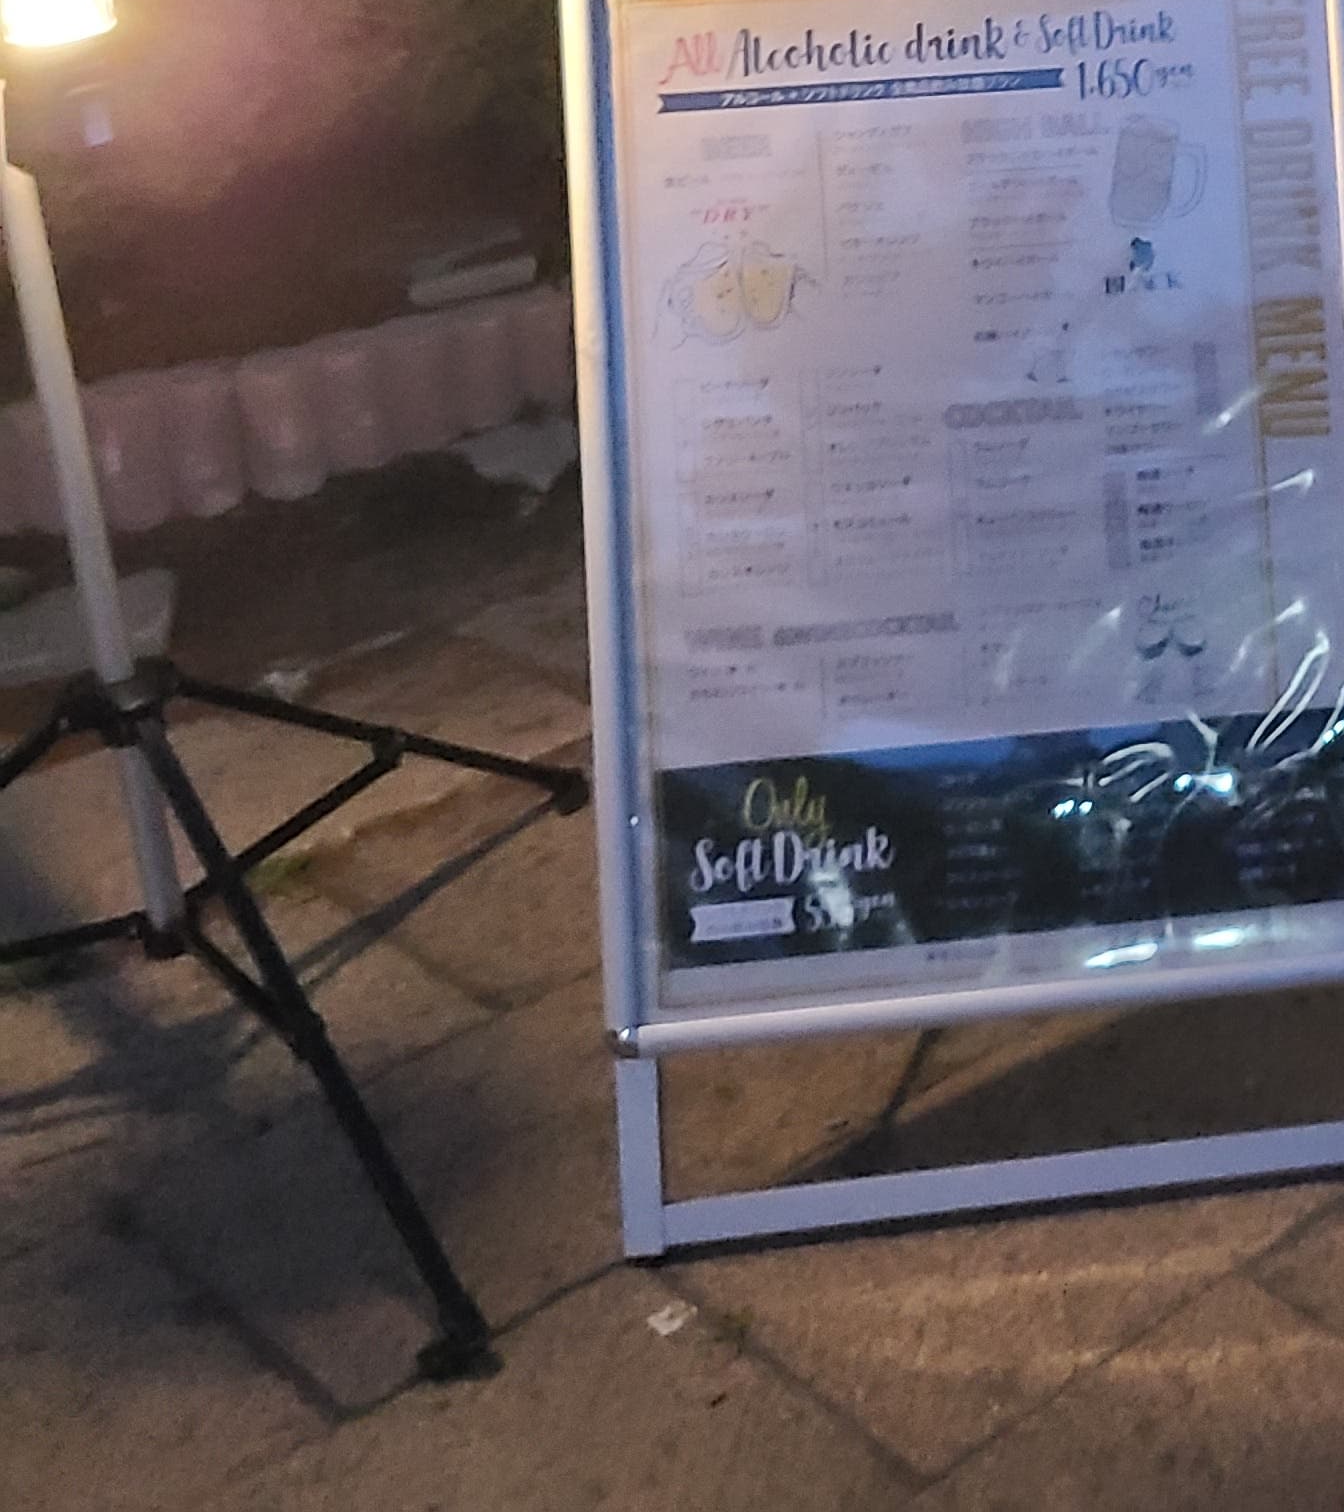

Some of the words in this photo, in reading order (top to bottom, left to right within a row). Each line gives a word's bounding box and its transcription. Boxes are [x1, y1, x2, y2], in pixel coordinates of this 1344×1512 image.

[659, 31, 719, 85] All
[726, 27, 892, 80] Alcoholic
[904, 22, 1006, 63] drink
[1093, 10, 1176, 50] Drink
[1253, 296, 1331, 438] MENU
[743, 776, 833, 844] Only
[690, 838, 773, 893] Soft
